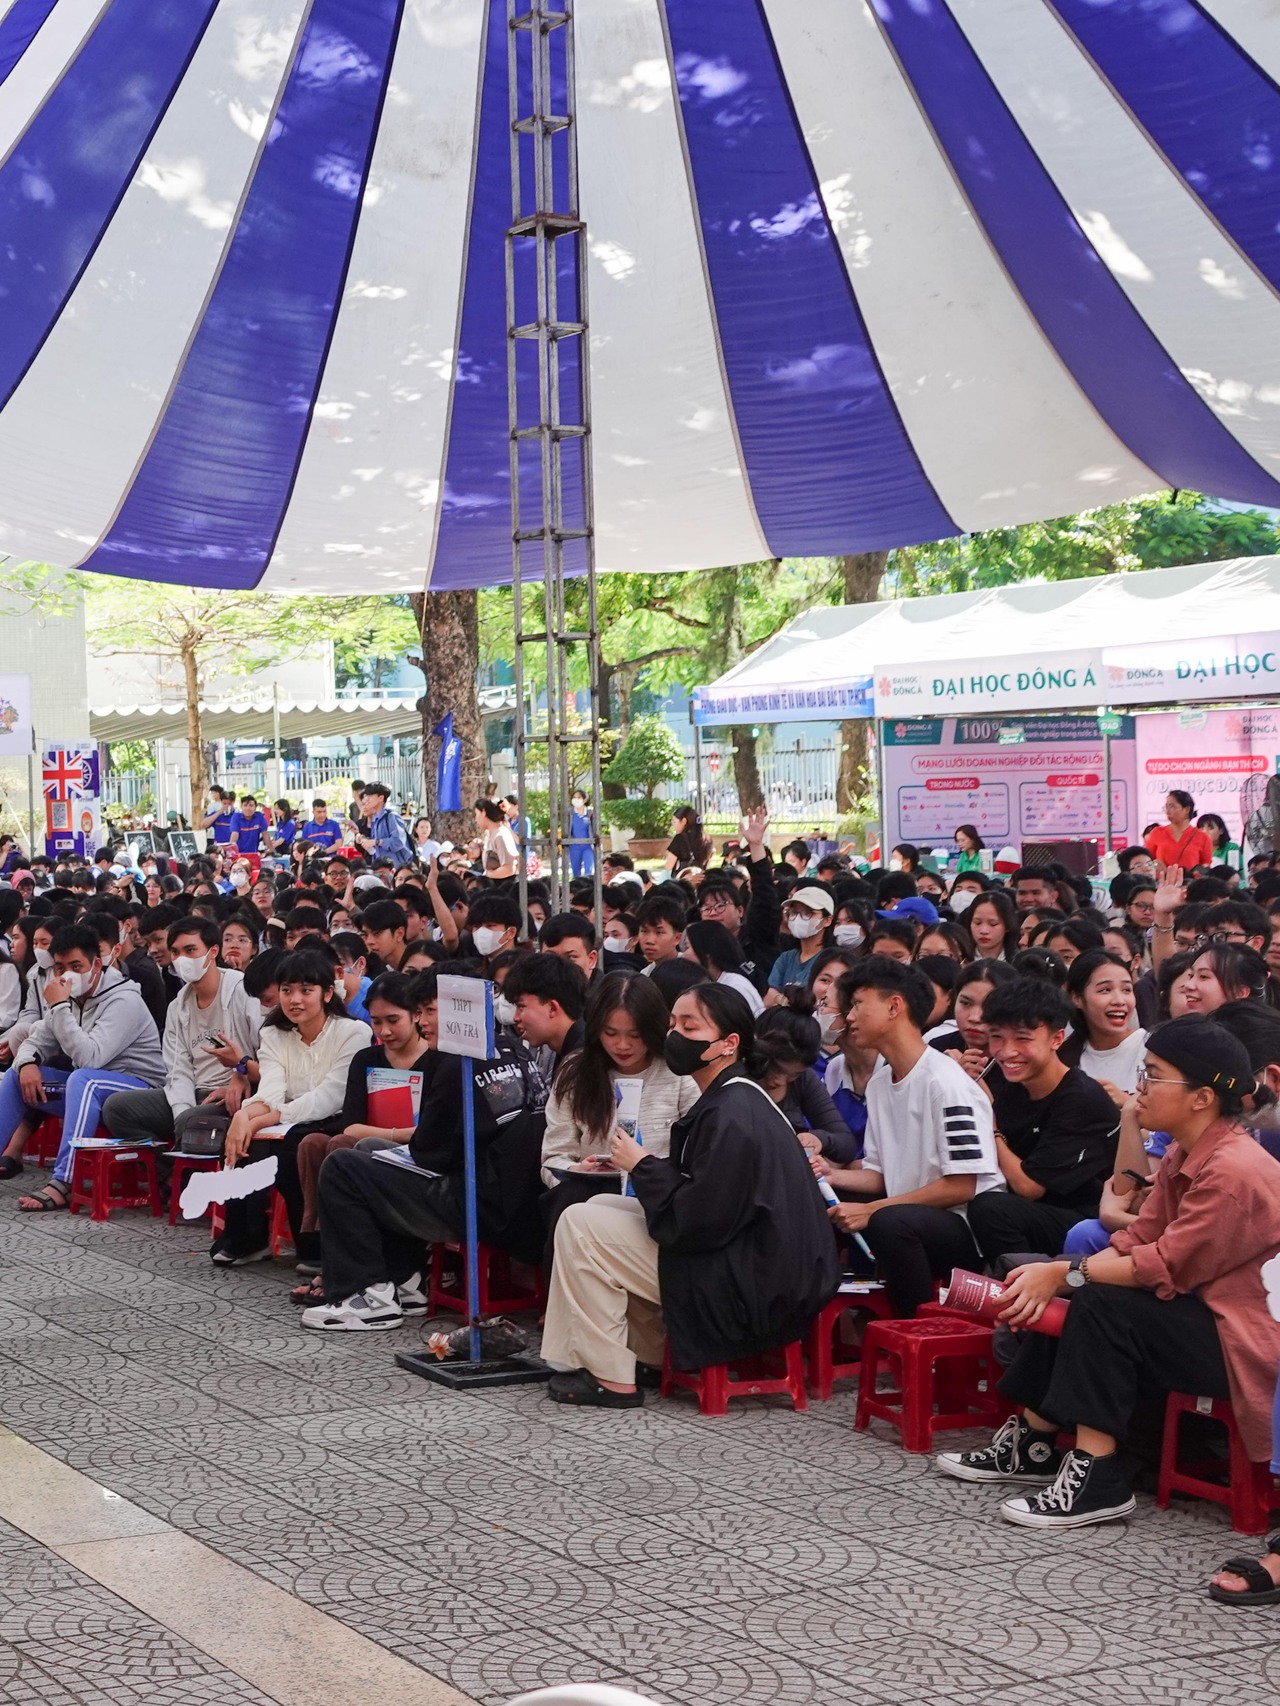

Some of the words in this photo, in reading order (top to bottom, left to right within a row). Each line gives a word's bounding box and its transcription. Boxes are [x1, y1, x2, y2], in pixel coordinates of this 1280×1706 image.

[1176, 659, 1216, 683] ĐẠI
[1225, 652, 1277, 679] HỌC
[932, 678, 965, 700] ĐẠI
[970, 674, 1012, 698] HỌC
[1017, 667, 1077, 691] ĐÔNG
[1083, 662, 1096, 686] Á
[966, 758, 997, 767] DOANH
[452, 998, 472, 1012] THPT
